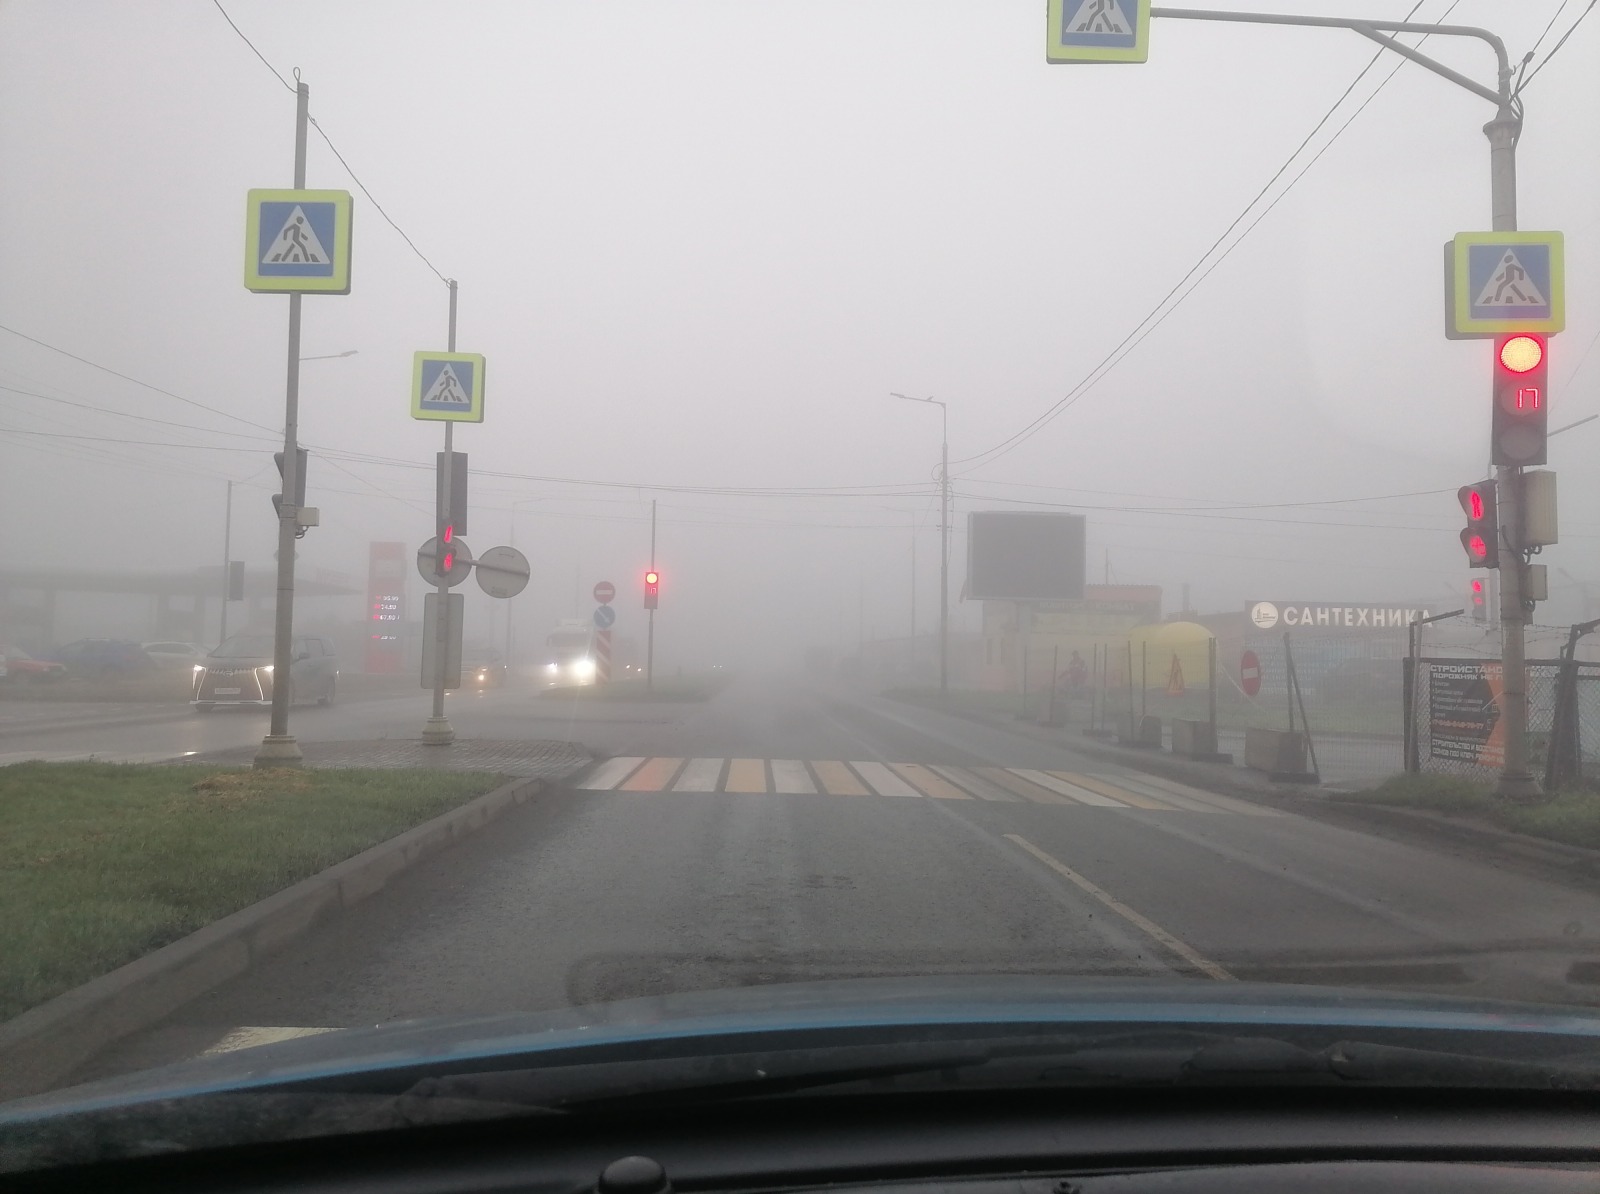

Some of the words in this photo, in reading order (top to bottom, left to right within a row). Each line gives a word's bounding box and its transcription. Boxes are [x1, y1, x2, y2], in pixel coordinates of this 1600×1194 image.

[1517, 387, 1538, 409] 17
[1283, 606, 1433, 628] САНТЕХНИКА
[1433, 672, 1478, 681] ПОРОЖНЯК
